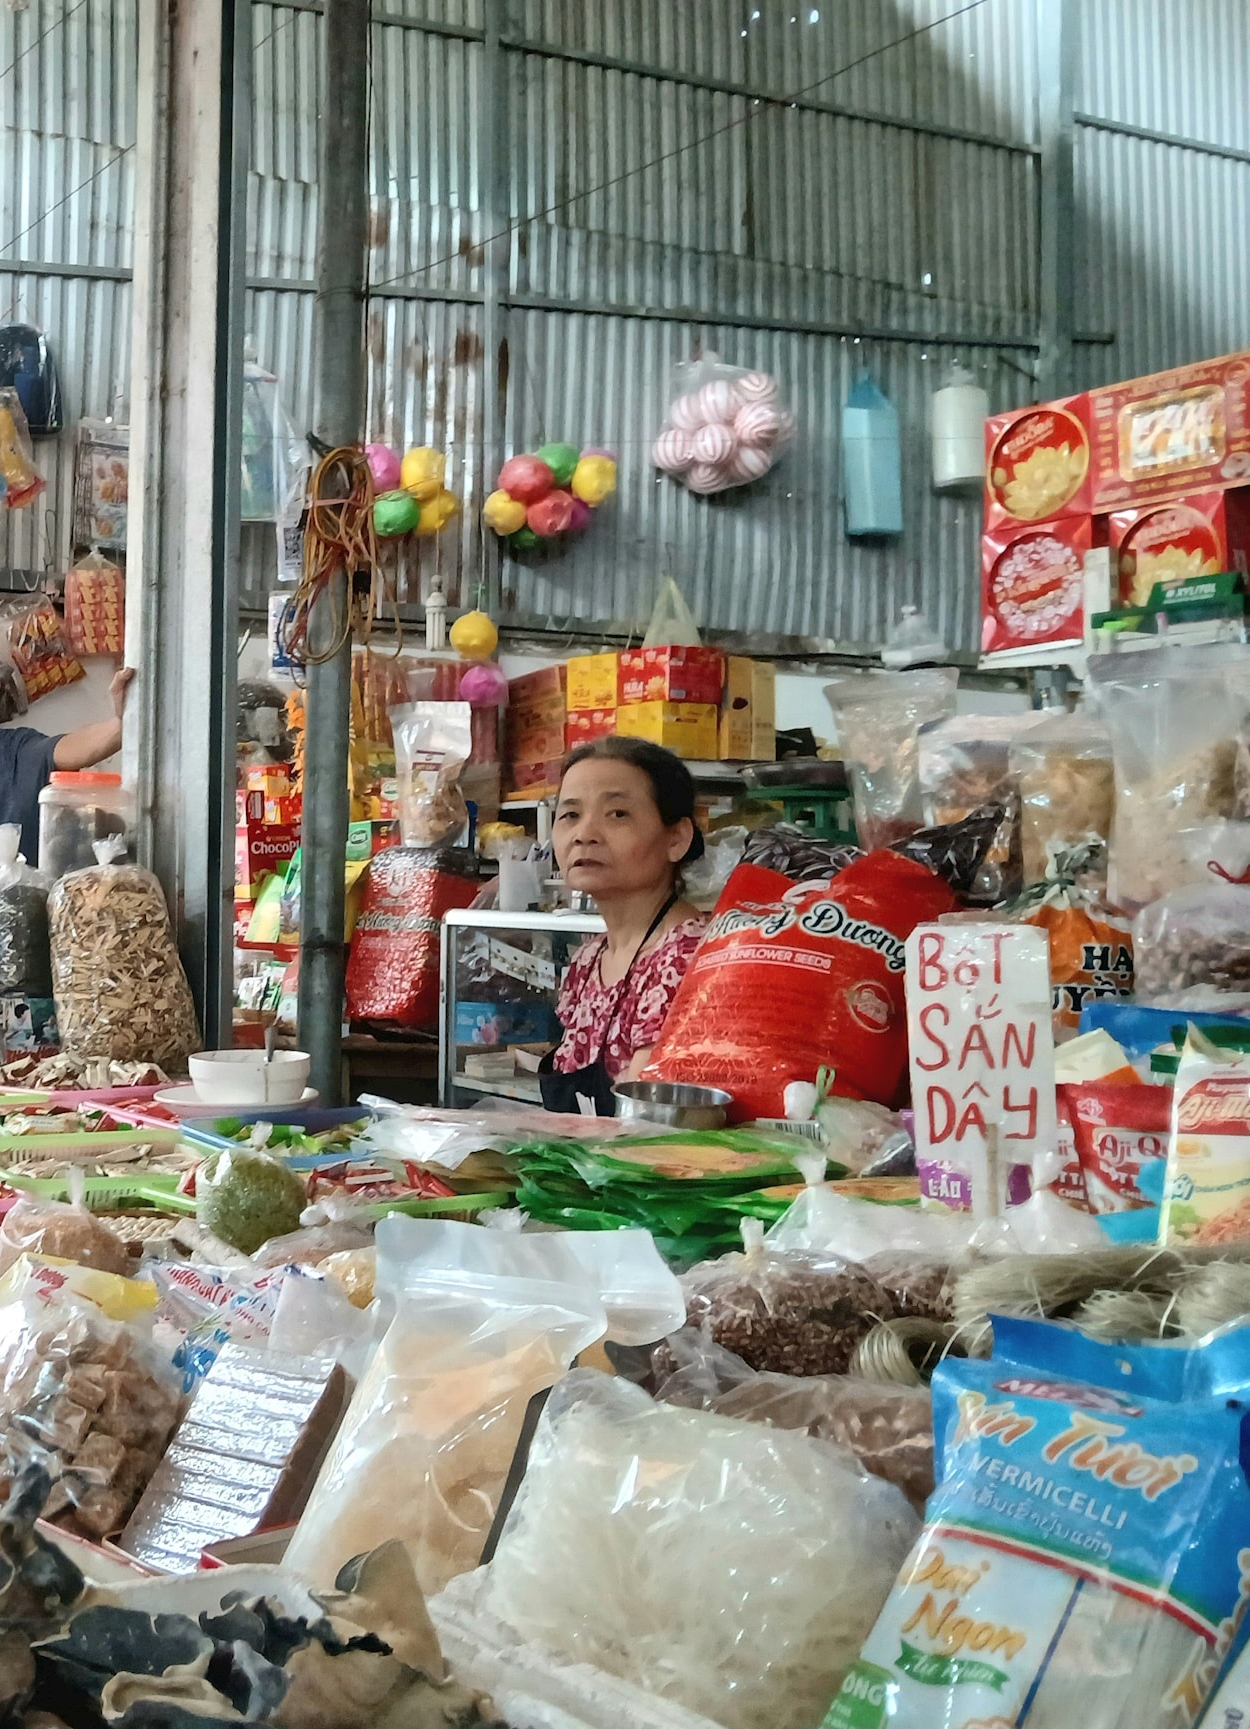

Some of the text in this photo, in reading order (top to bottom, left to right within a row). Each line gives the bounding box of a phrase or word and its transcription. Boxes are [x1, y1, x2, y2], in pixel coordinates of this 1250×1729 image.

[251, 840, 300, 854] ChocoPi
[794, 953, 831, 969] SEEDS
[1082, 946, 1134, 979] HẠ
[916, 993, 1036, 1071] SẮN
[926, 1081, 1038, 1144] DÂY
[1099, 1134, 1168, 1164] Aji-Q
[970, 1452, 1129, 1530] VERMICELLI
[901, 1592, 1027, 1662] Ngon
